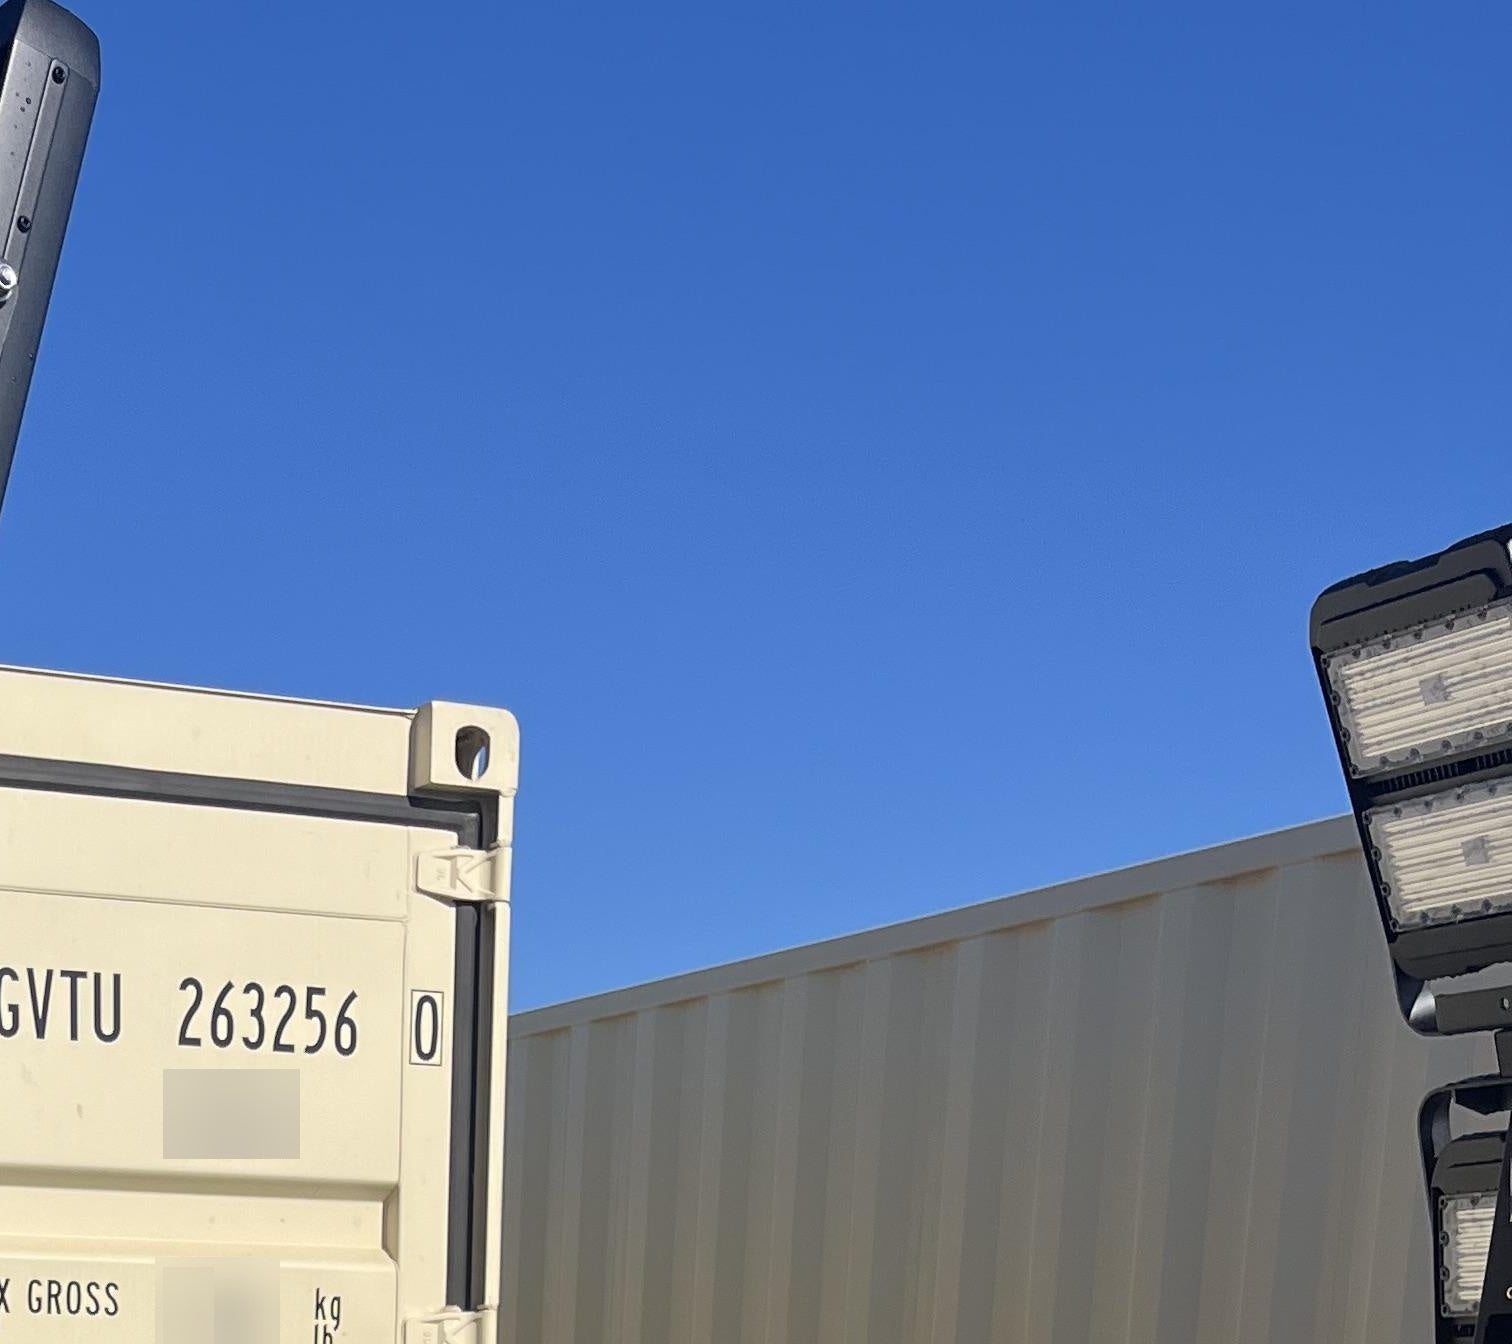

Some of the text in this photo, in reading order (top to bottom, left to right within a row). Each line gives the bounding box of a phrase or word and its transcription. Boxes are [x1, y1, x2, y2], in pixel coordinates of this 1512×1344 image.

[177, 976, 359, 1057] 263256
[414, 994, 440, 1061] 0
[27, 1279, 120, 1317] GROSS
[314, 1289, 343, 1331] kg
